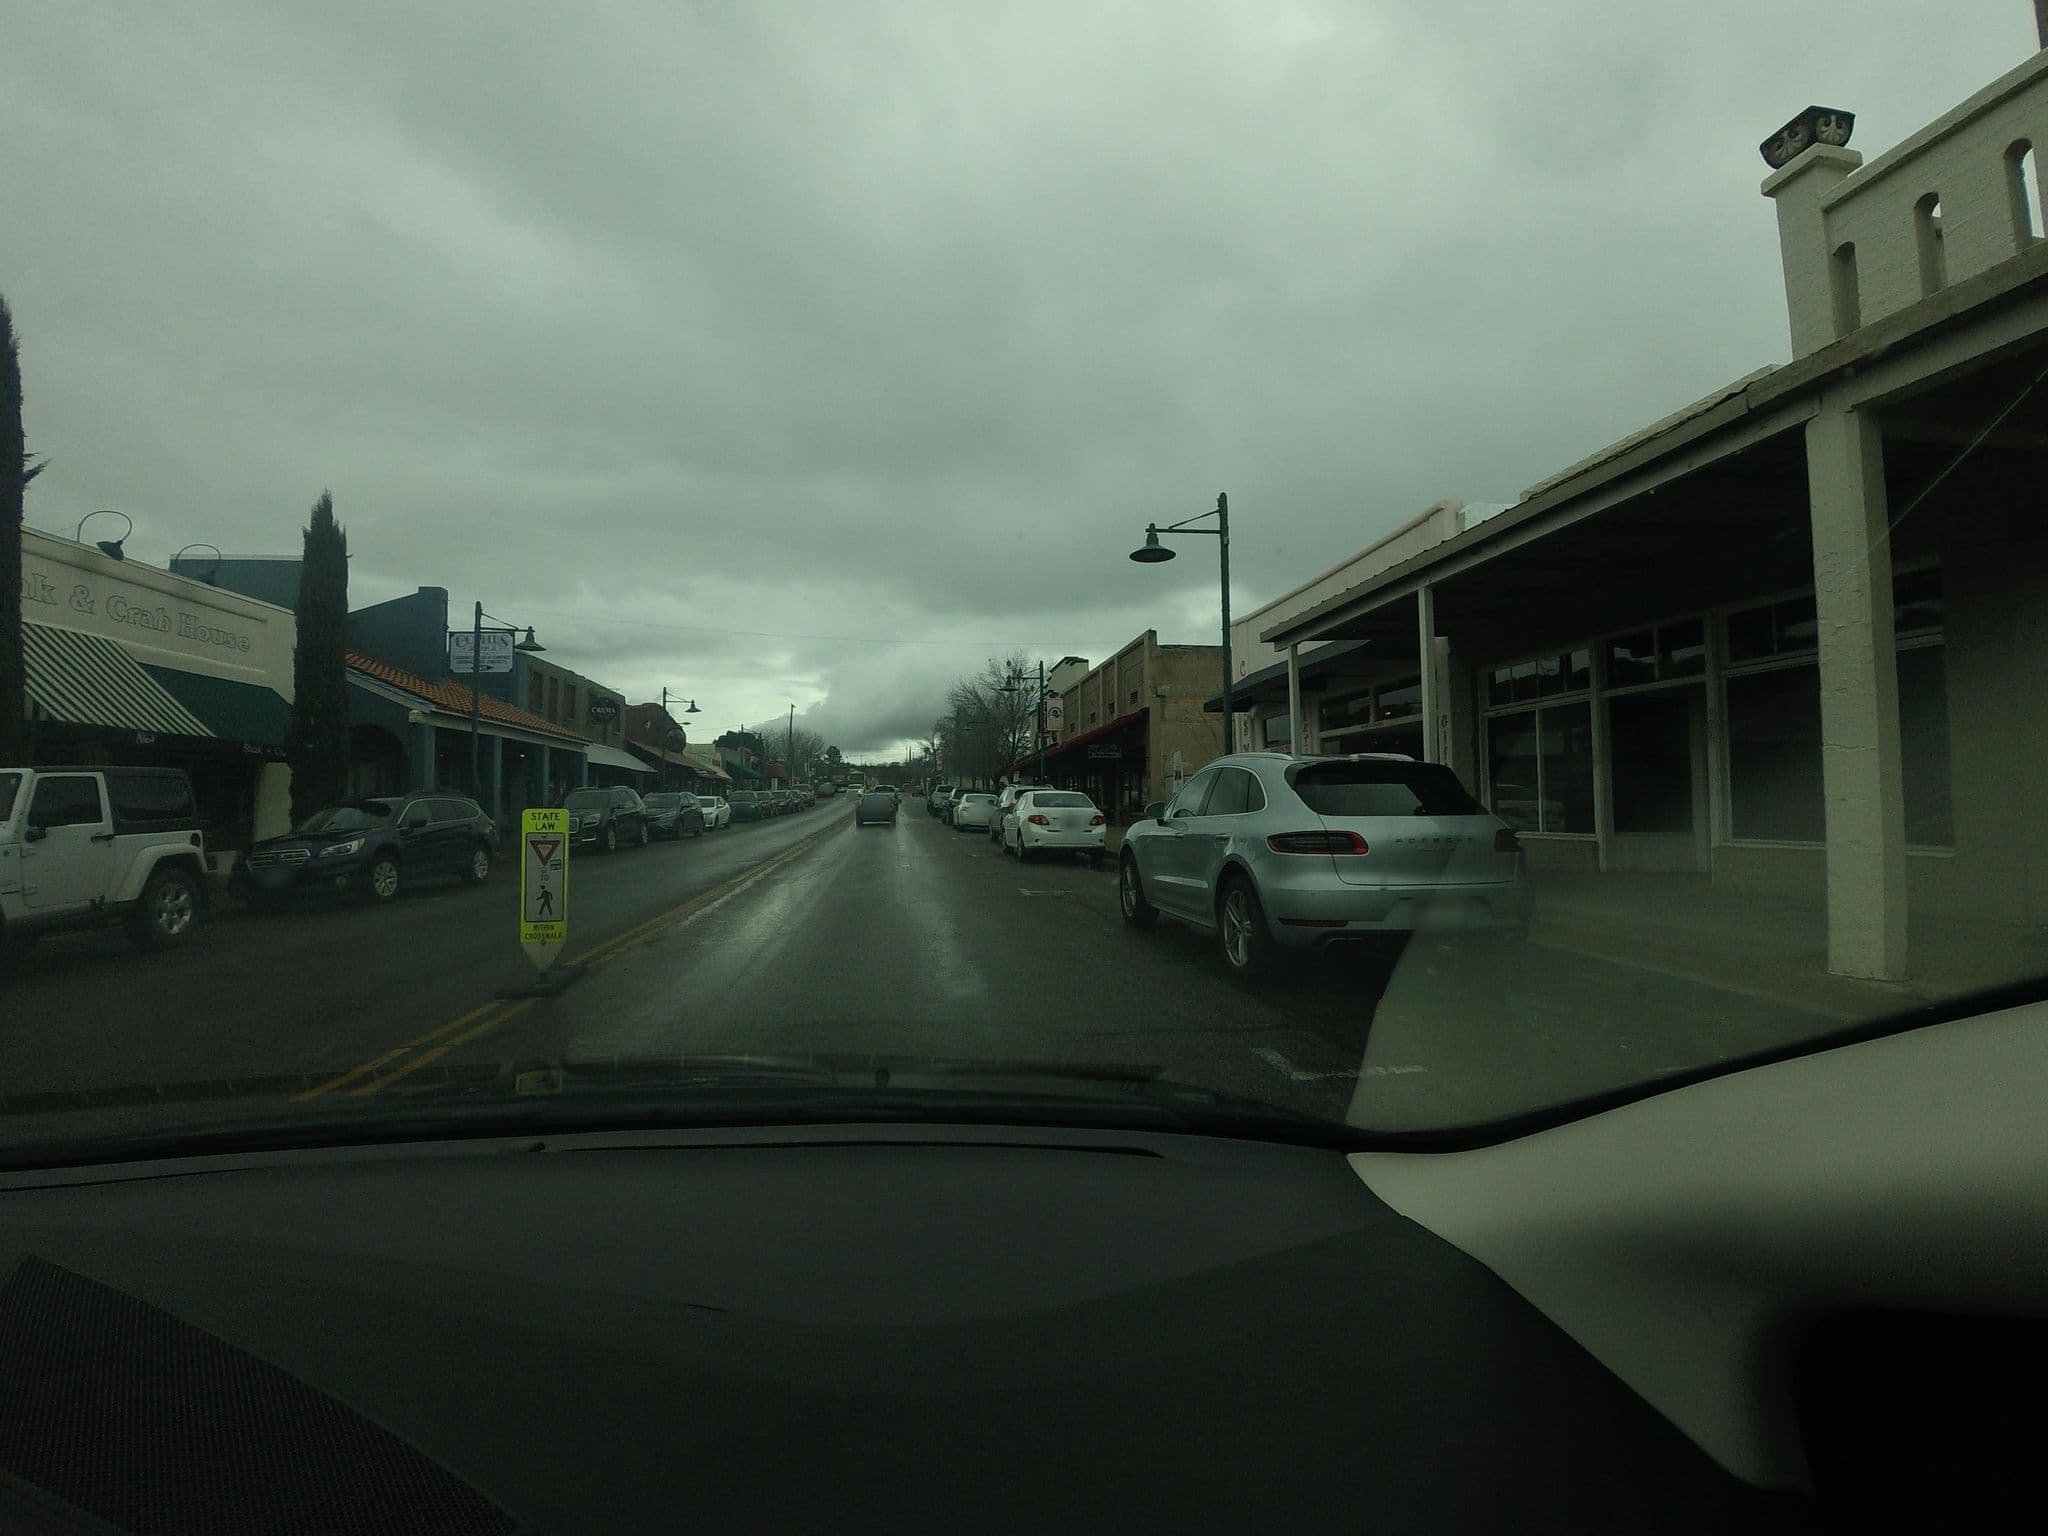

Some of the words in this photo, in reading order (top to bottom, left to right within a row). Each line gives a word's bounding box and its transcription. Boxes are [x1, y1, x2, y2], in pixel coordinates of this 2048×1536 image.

[69, 584, 96, 615] &
[106, 595, 169, 632] Crab
[178, 612, 250, 652] House
[531, 812, 561, 821] STATE
[535, 822, 555, 831] LAW
[540, 874, 550, 882] TO
[525, 932, 563, 940] CROSSWALK
